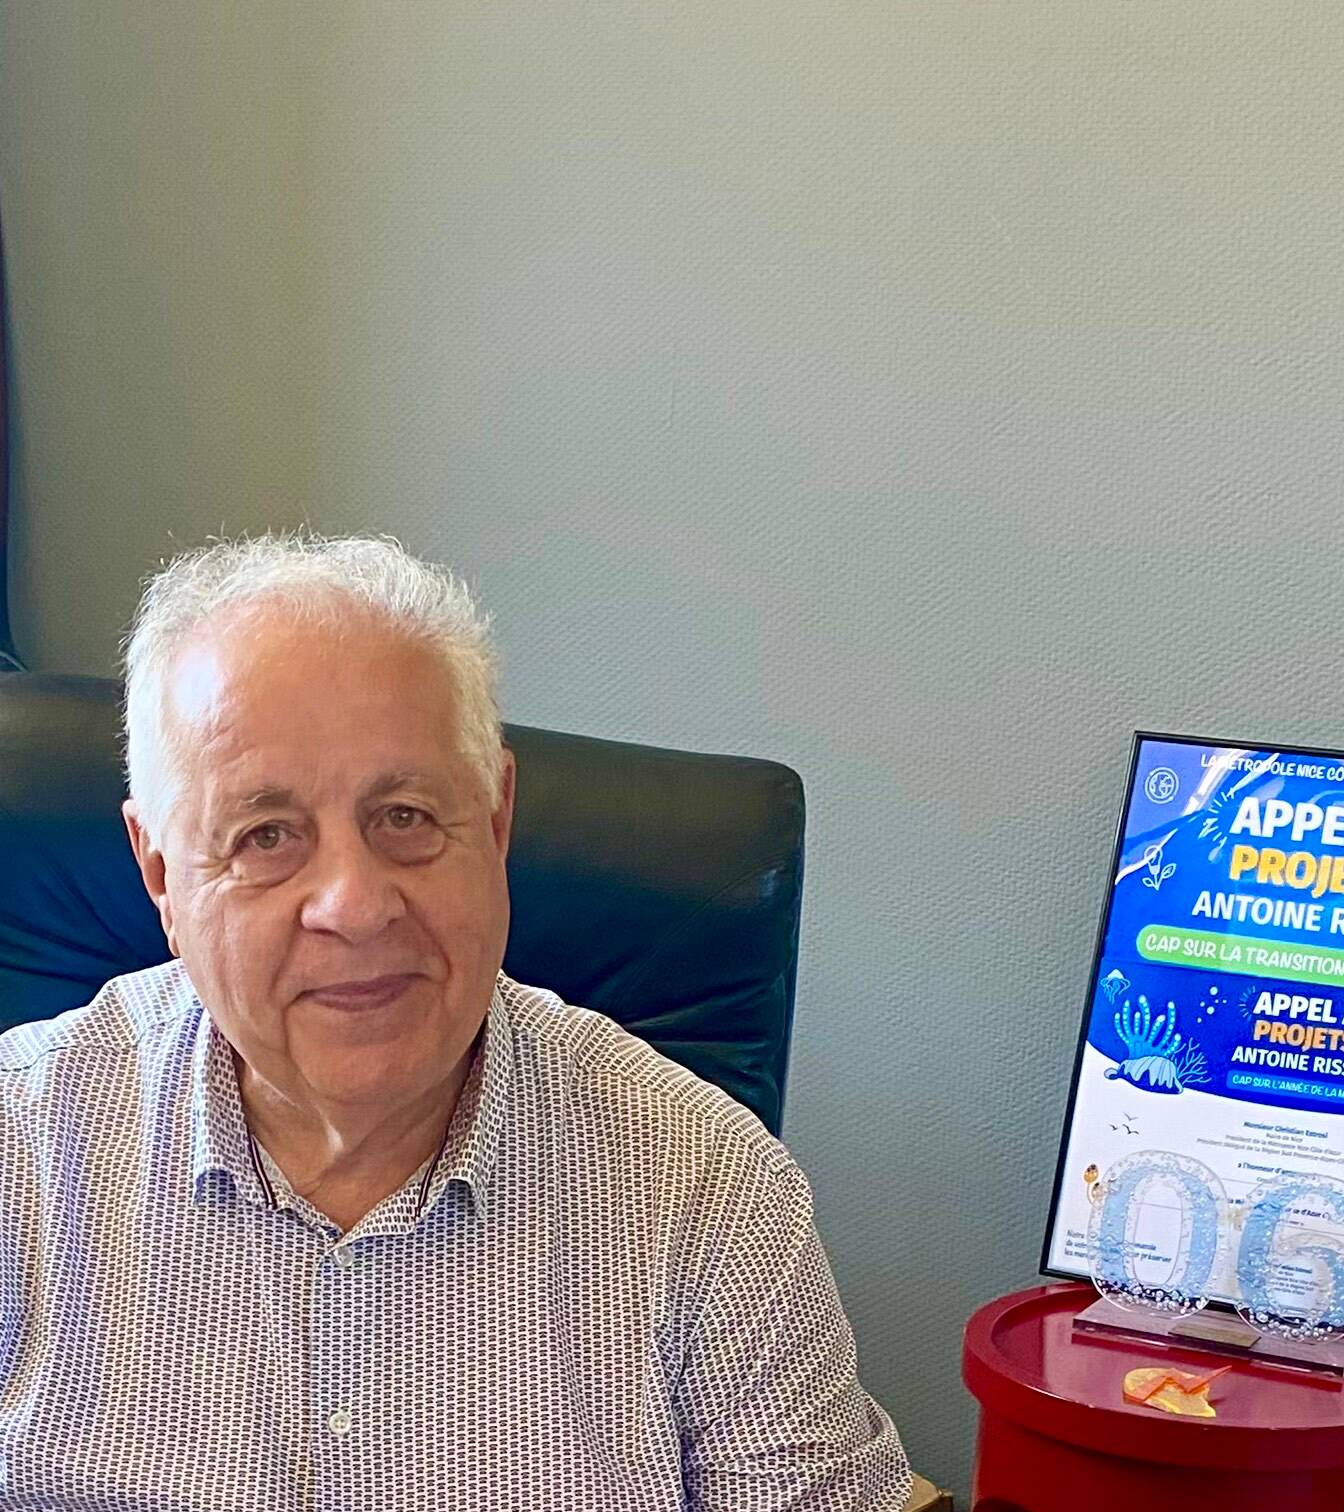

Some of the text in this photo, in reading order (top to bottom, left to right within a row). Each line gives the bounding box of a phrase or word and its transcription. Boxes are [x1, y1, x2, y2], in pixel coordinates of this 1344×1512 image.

[1296, 765, 1325, 780] NICE
[1191, 890, 1324, 932] ANTOINE
[1144, 932, 1181, 952] CAP
[1183, 937, 1217, 959] SUR
[1219, 940, 1243, 962] LA
[1253, 991, 1337, 1024] APPEL
[1231, 1045, 1310, 1072] ANTOINE
[1232, 1074, 1253, 1085] CAP
[1252, 1076, 1272, 1087] SUR
[1272, 1079, 1309, 1094] L'ANNÉE
[1310, 1084, 1324, 1095] DE
[1324, 1087, 1337, 1097] LA
